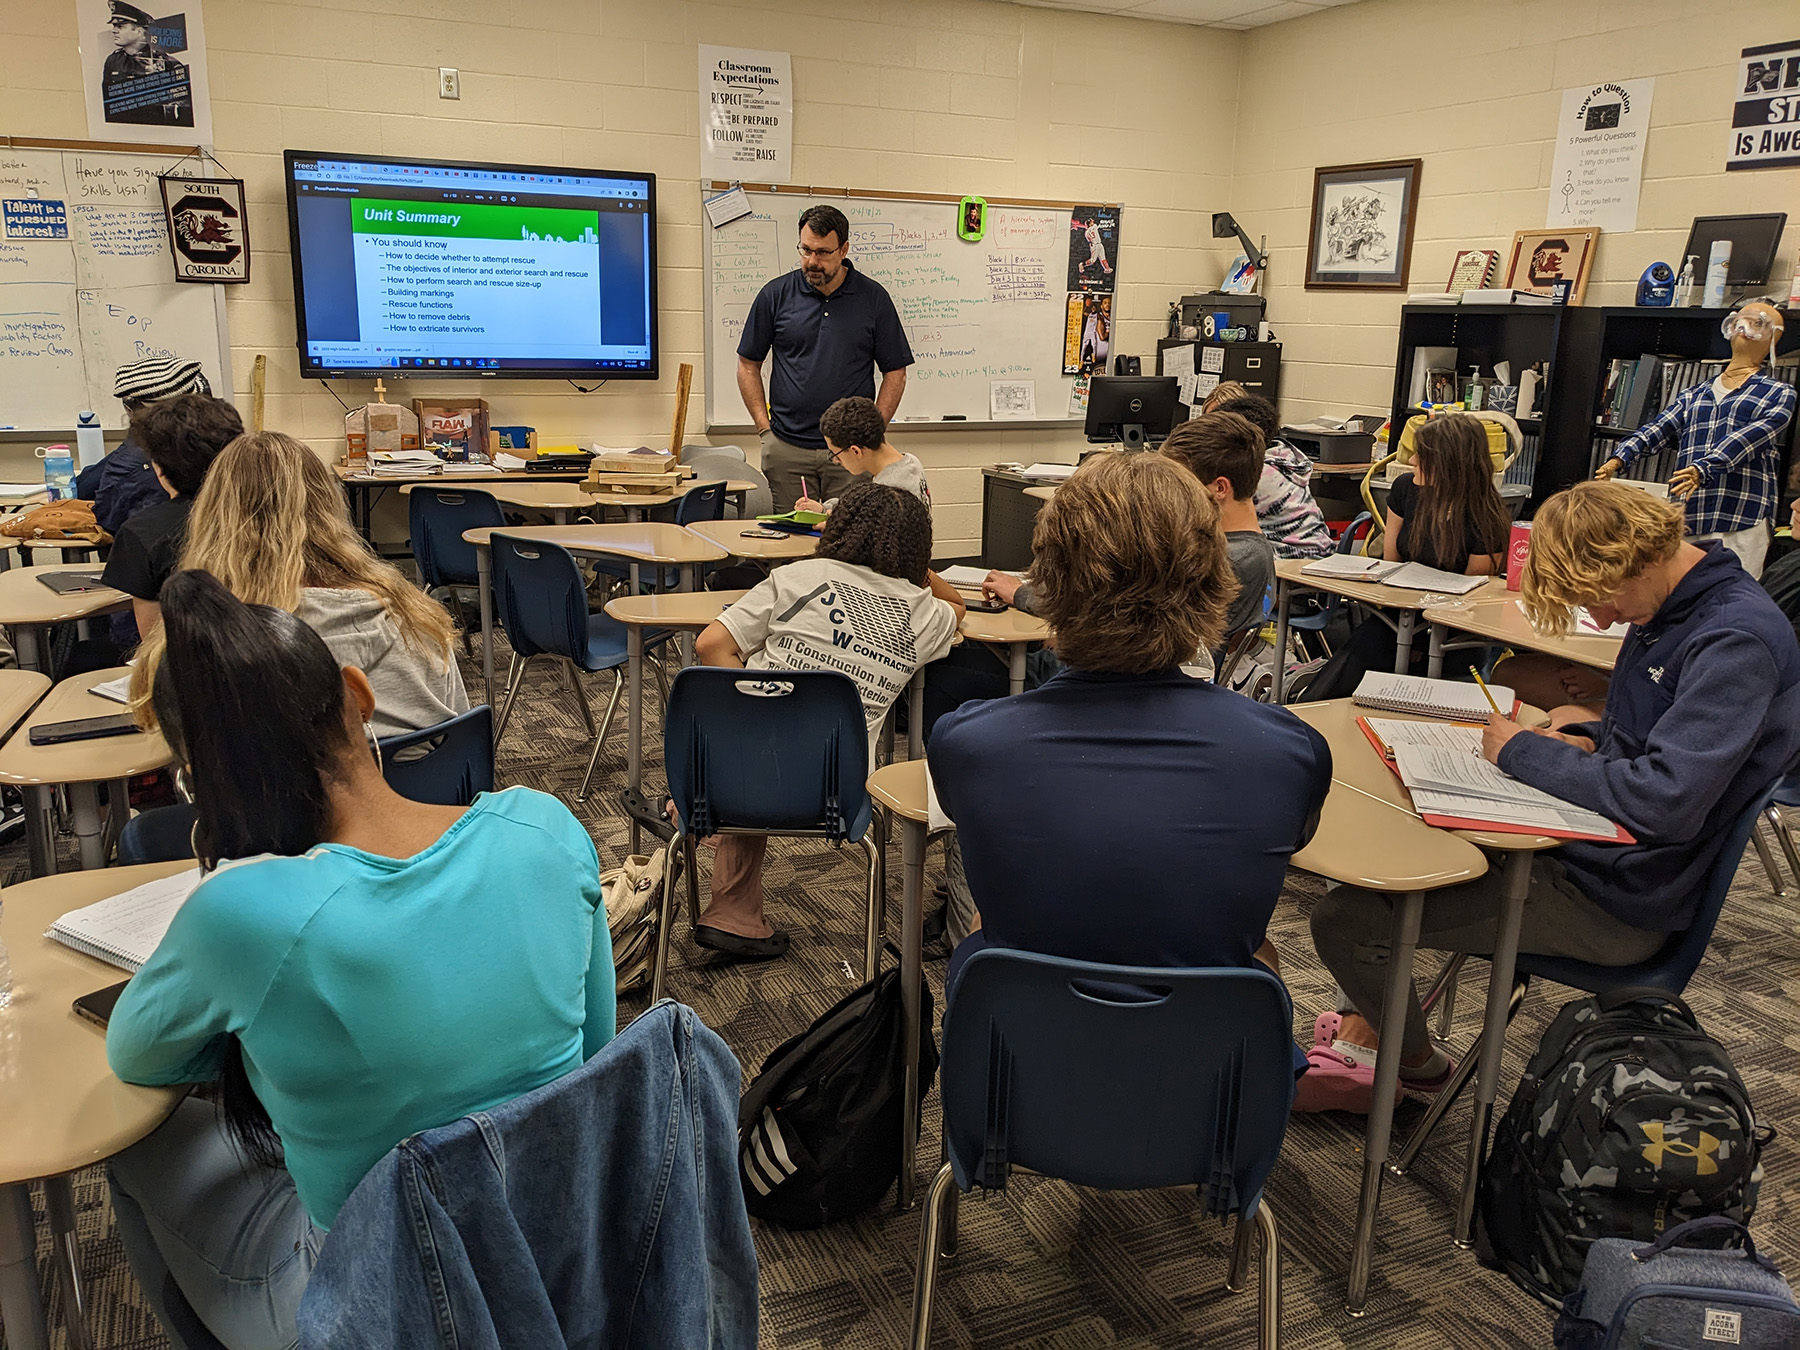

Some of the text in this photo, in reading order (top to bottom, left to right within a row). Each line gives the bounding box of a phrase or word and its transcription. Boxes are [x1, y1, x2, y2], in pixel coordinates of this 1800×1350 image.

[159, 36, 183, 48] MORE
[719, 60, 772, 73] Classroom
[713, 71, 779, 85] Expectations
[712, 92, 742, 106] RESPECT
[1576, 83, 1630, 120] How to Question
[732, 114, 740, 124] BE
[743, 115, 779, 126] PREPARED
[713, 129, 744, 142] FOLLOW
[1569, 131, 1636, 145] 5 Powerful Questions
[1735, 133, 1754, 156] Is
[756, 149, 777, 161] RAISE
[1586, 148, 1600, 156] What
[1609, 148, 1619, 157] you
[1619, 145, 1638, 154] think?
[294, 161, 319, 171] Freeze
[1584, 158, 1596, 168] Why
[1604, 158, 1616, 167] you
[1616, 156, 1630, 164] think
[1582, 168, 1597, 176] that?
[1582, 178, 1594, 186] How
[1603, 178, 1614, 187] you
[1614, 175, 1630, 183] know
[184, 184, 220, 195] SOUTH
[1580, 188, 1594, 196] this?
[1580, 198, 1590, 206] Can
[1590, 198, 1601, 208] you
[1602, 196, 1611, 205] tell
[364, 208, 462, 228] Unit Summary
[1578, 208, 1596, 216] more?
[6, 215, 67, 225] PURSUED
[1578, 217, 1593, 228] Why?
[7, 225, 54, 237] interest
[372, 237, 448, 250] You should know
[385, 251, 536, 266] How to decide whether to attempt rescue
[185, 263, 238, 278] CAROLINA
[386, 263, 401, 272] The
[403, 265, 442, 275] objectives
[443, 265, 451, 273] of
[452, 266, 478, 275] interior
[479, 267, 494, 275] and
[495, 268, 523, 276] exterior
[524, 269, 549, 277] search
[387, 275, 405, 284] How
[406, 276, 414, 284] to
[415, 276, 446, 287] perform
[447, 277, 472, 287] search
[515, 280, 542, 290] size-up
[388, 288, 455, 300] Building markings
[1070, 293, 1085, 302] 22
[388, 300, 454, 310] Rescue functions
[389, 312, 406, 321] How
[408, 312, 416, 320] to
[447, 313, 471, 322] debris
[390, 324, 485, 335] How to extricate survivors
[1064, 364, 1080, 374] 23
[431, 419, 464, 430] RAW
[820, 592, 836, 606] J
[829, 608, 845, 625] C
[832, 629, 915, 675] W CONTRACTING
[777, 636, 792, 651] All
[795, 641, 875, 684] Construction
[1710, 1319, 1735, 1330] ACORN
[1707, 1327, 1736, 1338] STREET
